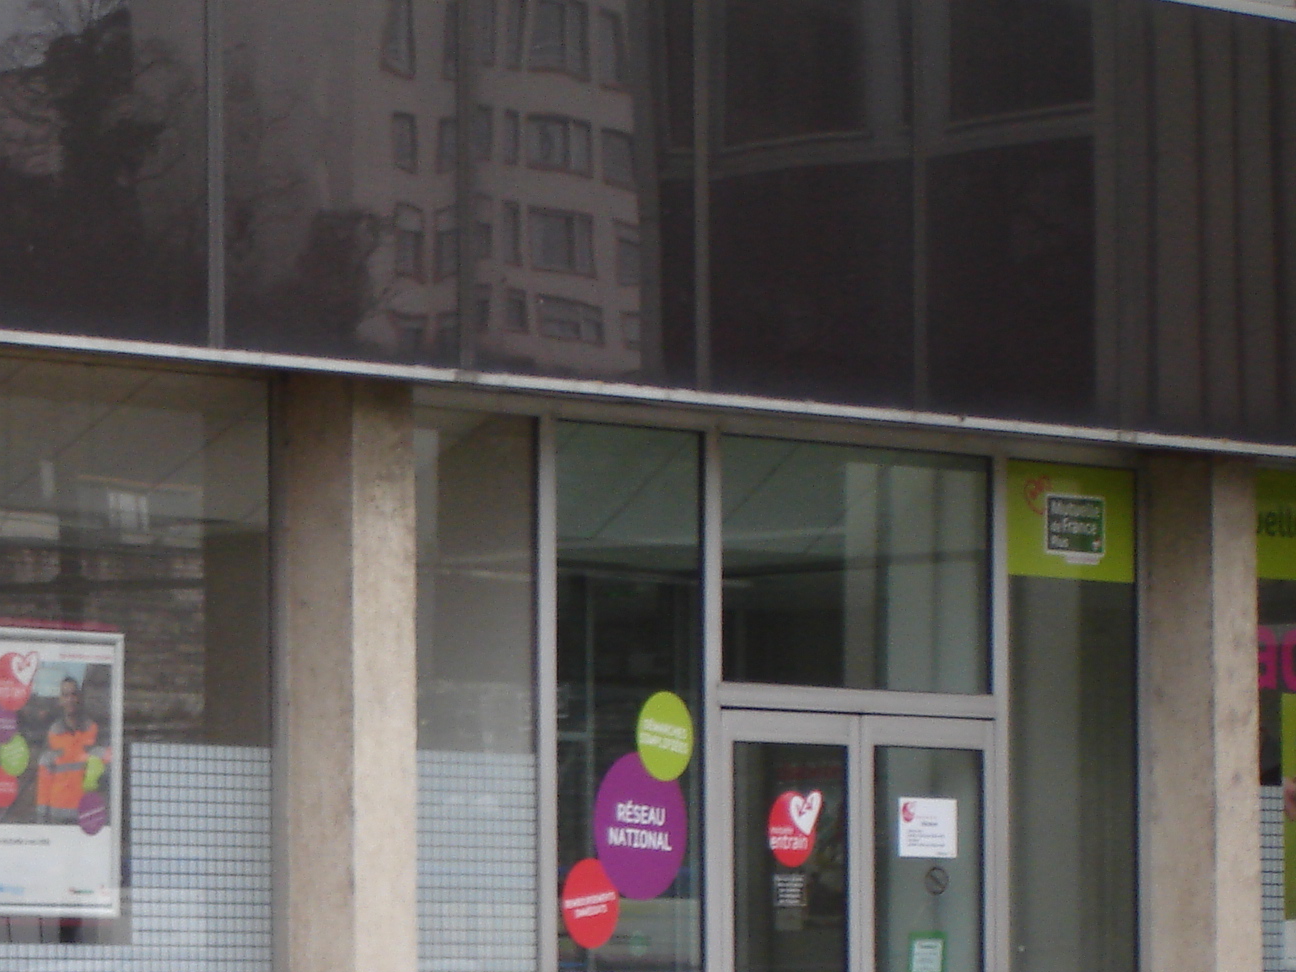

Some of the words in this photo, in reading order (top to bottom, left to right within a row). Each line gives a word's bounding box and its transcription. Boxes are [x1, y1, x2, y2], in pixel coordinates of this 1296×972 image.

[616, 800, 666, 827] RÉSEAU
[607, 827, 672, 852] NATIONAL
[769, 833, 809, 851] entrain
